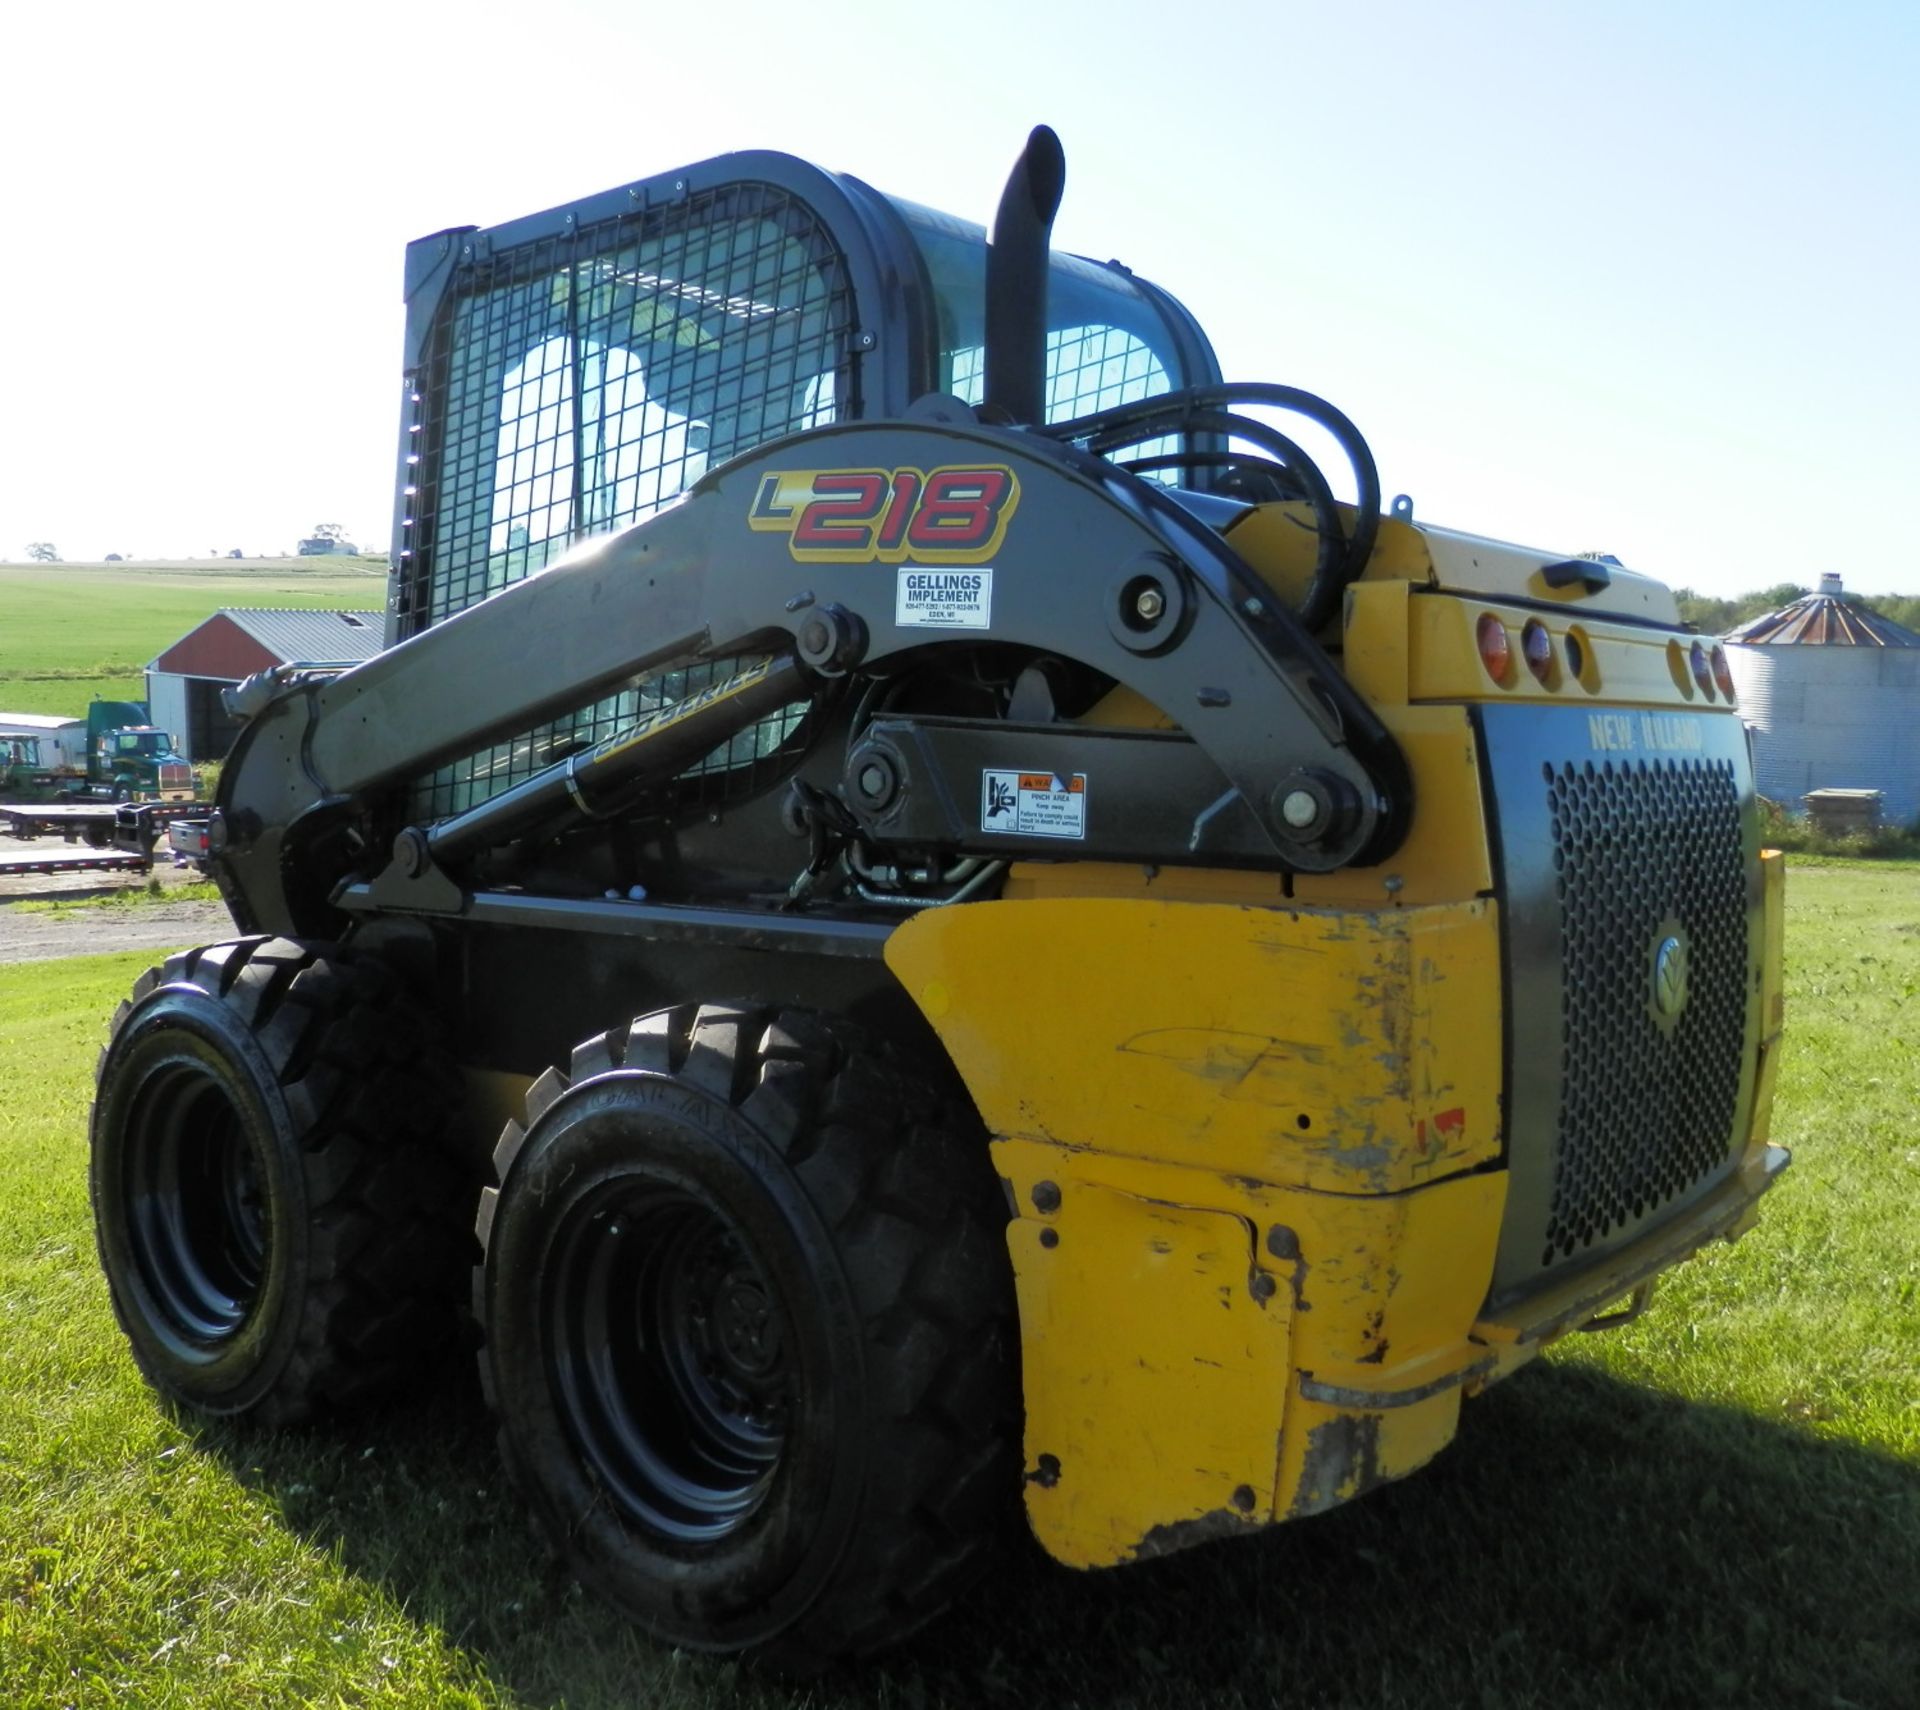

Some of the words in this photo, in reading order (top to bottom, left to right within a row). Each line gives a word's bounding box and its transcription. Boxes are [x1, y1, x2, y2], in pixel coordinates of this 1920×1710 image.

[749, 465, 1018, 561] L218
[906, 574, 982, 590] GELLINGS
[908, 590, 979, 602] IMPLEMENT
[1588, 714, 1634, 750] NEW
[1031, 793, 1050, 801] PINCH
